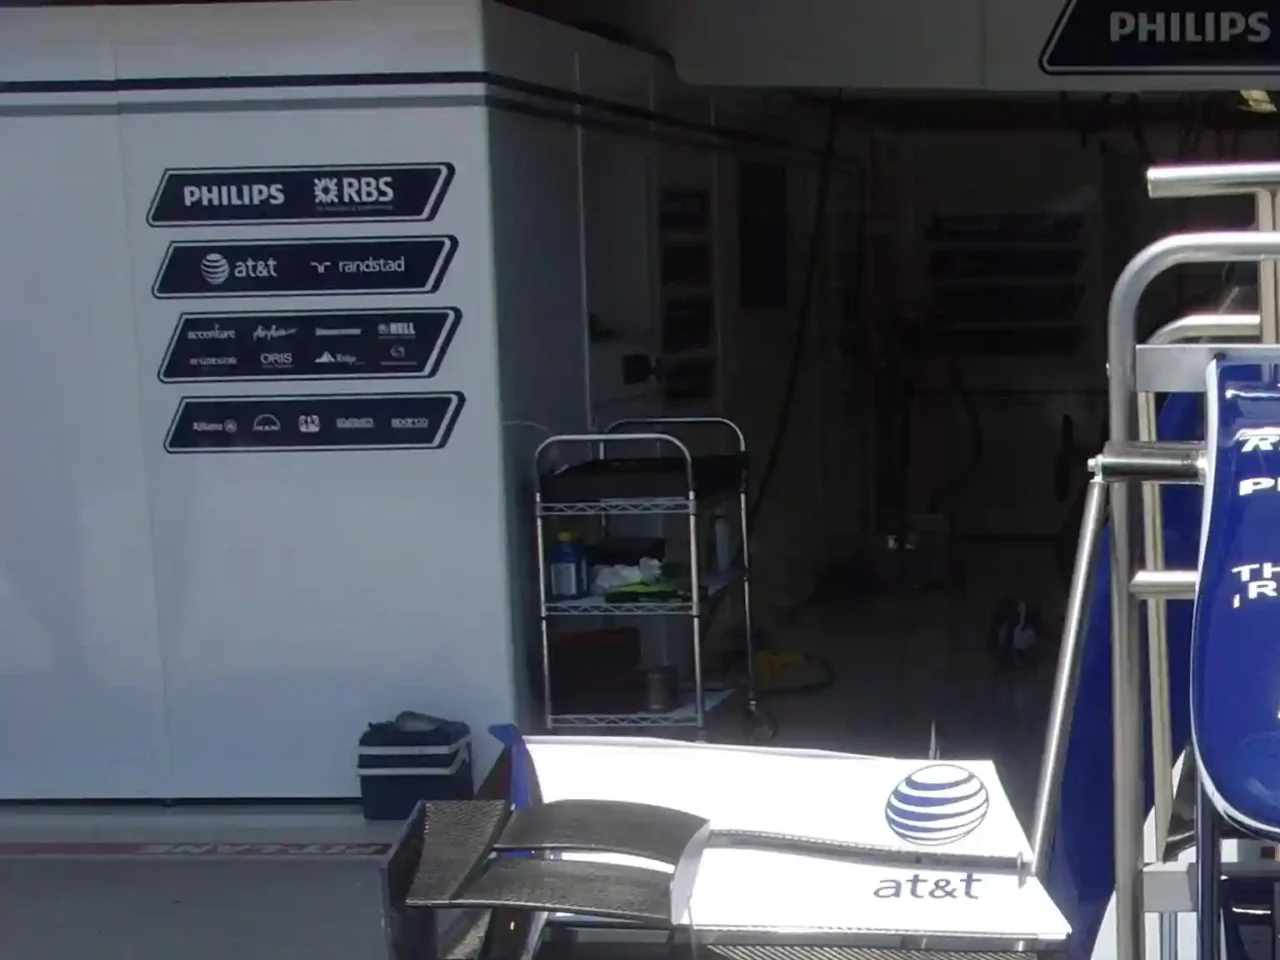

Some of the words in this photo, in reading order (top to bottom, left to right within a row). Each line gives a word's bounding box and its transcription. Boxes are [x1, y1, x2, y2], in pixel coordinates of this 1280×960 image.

[1110, 11, 1272, 43] PHILIPS
[183, 184, 285, 206] PHILIPS
[342, 177, 394, 202] RBS
[234, 257, 278, 278] at&t
[338, 256, 405, 273] randstad
[260, 352, 293, 364] ORIS
[873, 873, 982, 900] at&t
